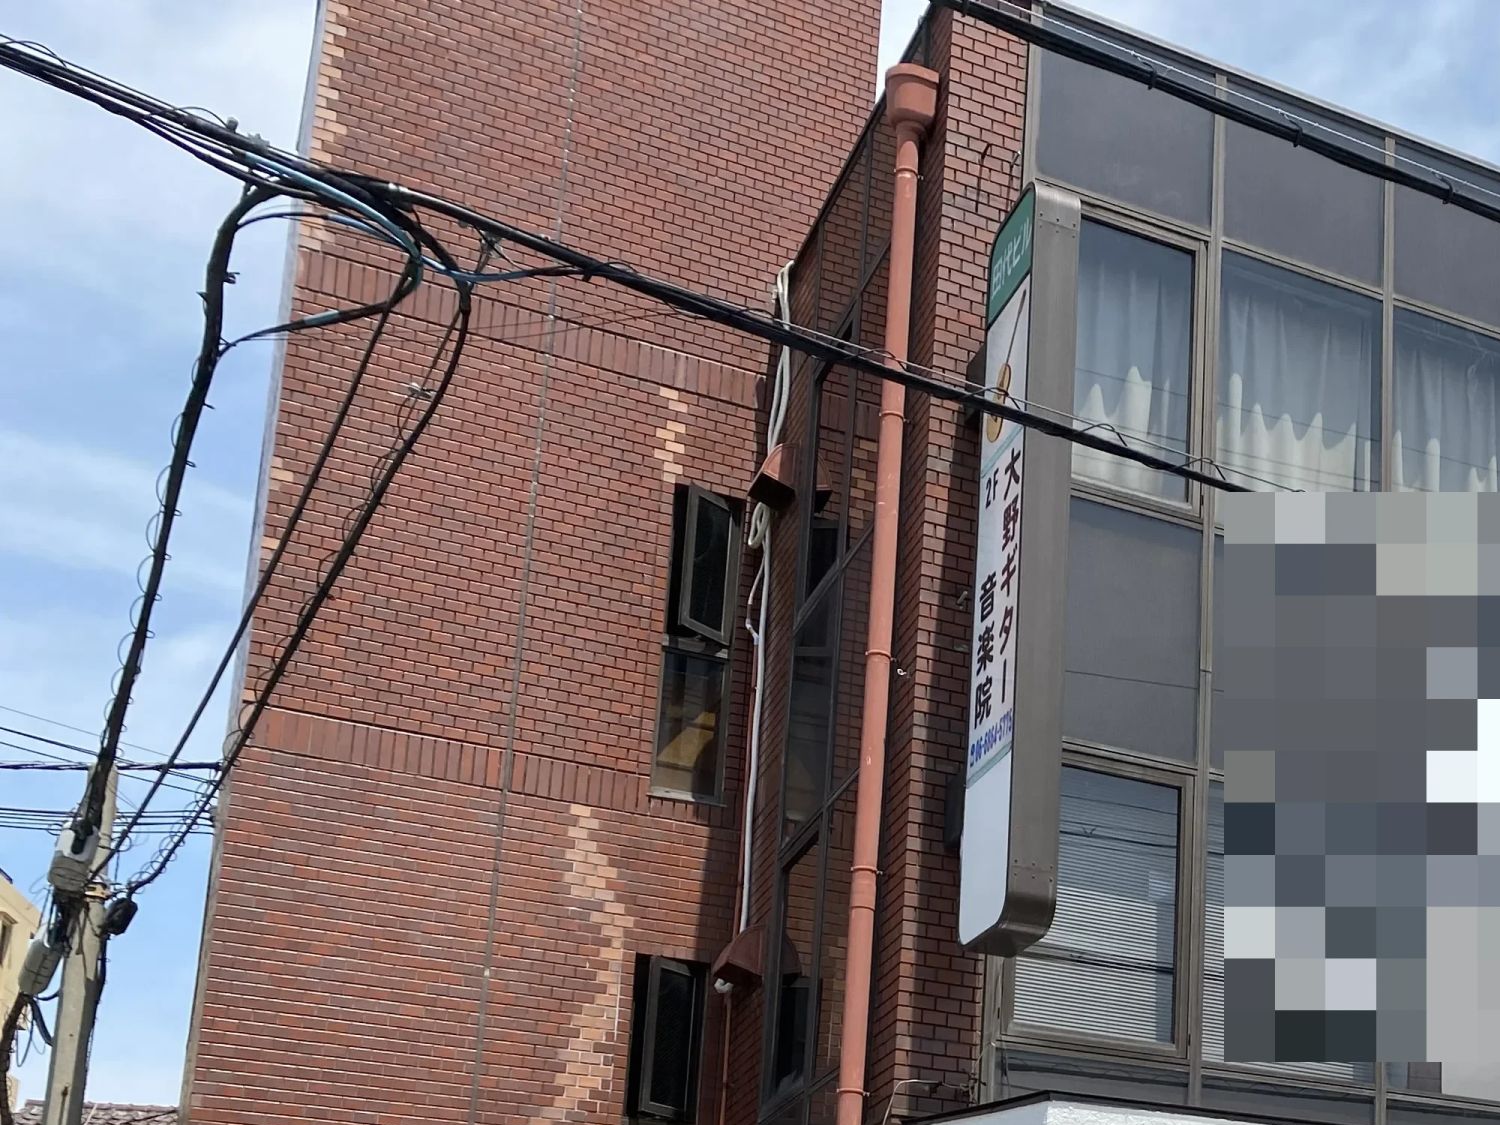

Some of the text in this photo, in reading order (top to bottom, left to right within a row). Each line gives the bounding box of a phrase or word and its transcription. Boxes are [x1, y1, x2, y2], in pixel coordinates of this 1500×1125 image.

[985, 468, 999, 508] 2F
[974, 571, 997, 729] 音楽院
[999, 448, 1021, 704] 大野ギター
